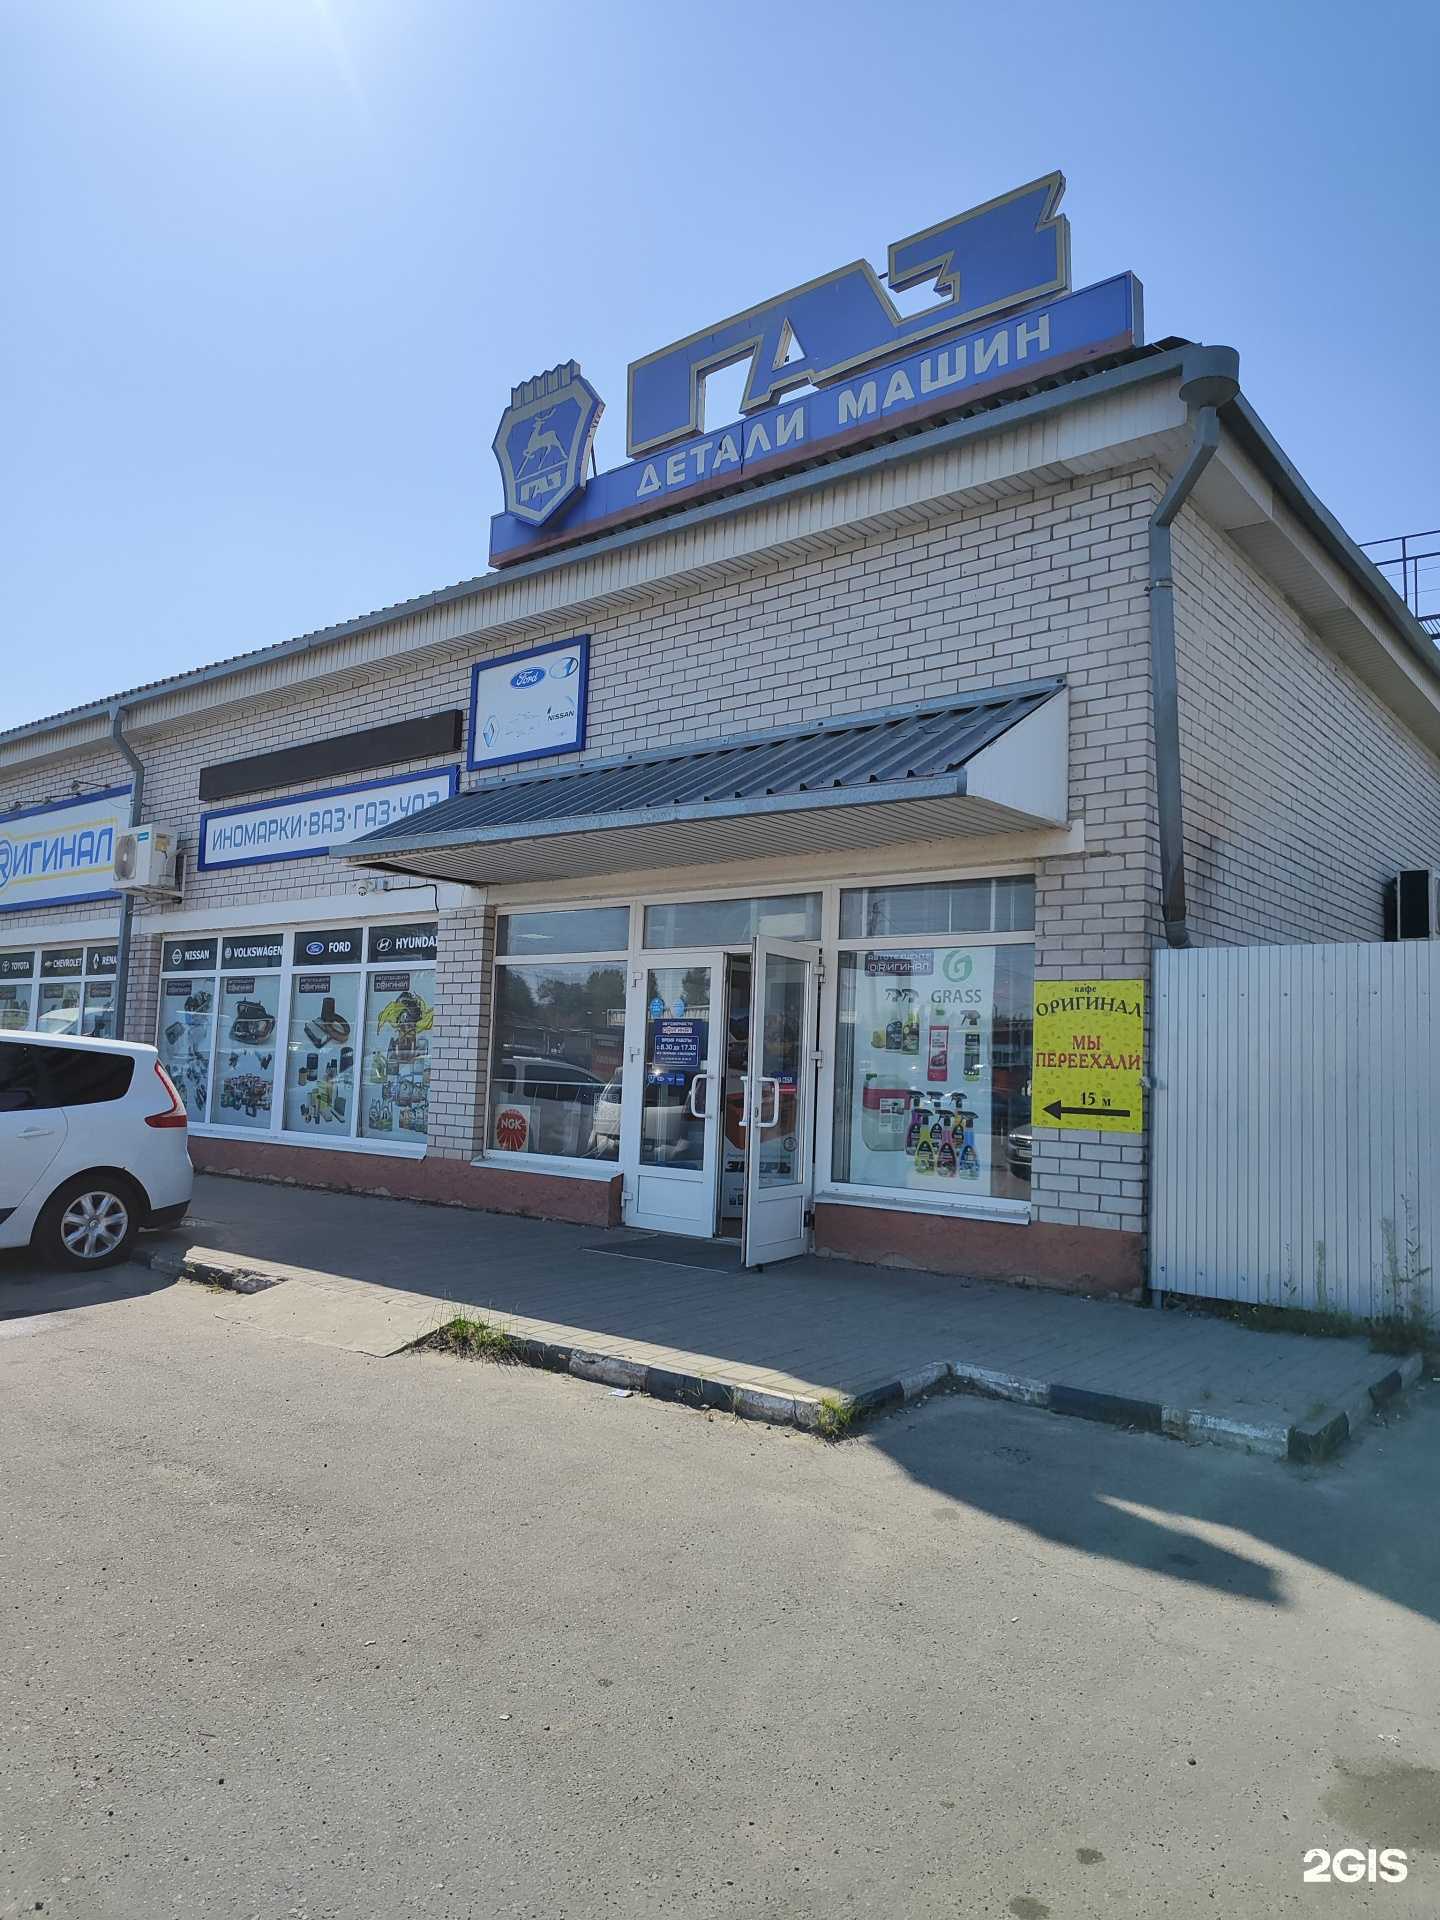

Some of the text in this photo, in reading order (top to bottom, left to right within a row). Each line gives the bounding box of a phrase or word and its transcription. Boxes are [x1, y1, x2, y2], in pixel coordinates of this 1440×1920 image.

[627, 170, 1072, 459] ГАЗ
[636, 312, 1051, 498] ДЕТАЛИ МАШИН
[519, 470, 563, 504] ГАЗ
[547, 709, 575, 721] NISSAN
[212, 814, 301, 850] ИНОМАРКИ
[328, 941, 352, 953] FORD
[395, 935, 438, 950] HYUNDAI
[184, 949, 210, 961] NISSAN
[233, 945, 283, 958] VOLKSWAGEN
[11, 960, 30, 970] TOYOTA
[53, 957, 82, 968] CHEVROLET
[1074, 983, 1097, 995] кафе
[930, 989, 982, 1004] GRASS
[1036, 996, 1142, 1017] ОРИГИНАЛ
[1072, 1035, 1102, 1050] МЫ
[1035, 1052, 1141, 1070] ПЕРЕЕХАЛИ
[1081, 1091, 1096, 1105] 15
[501, 1117, 522, 1130] NGK
